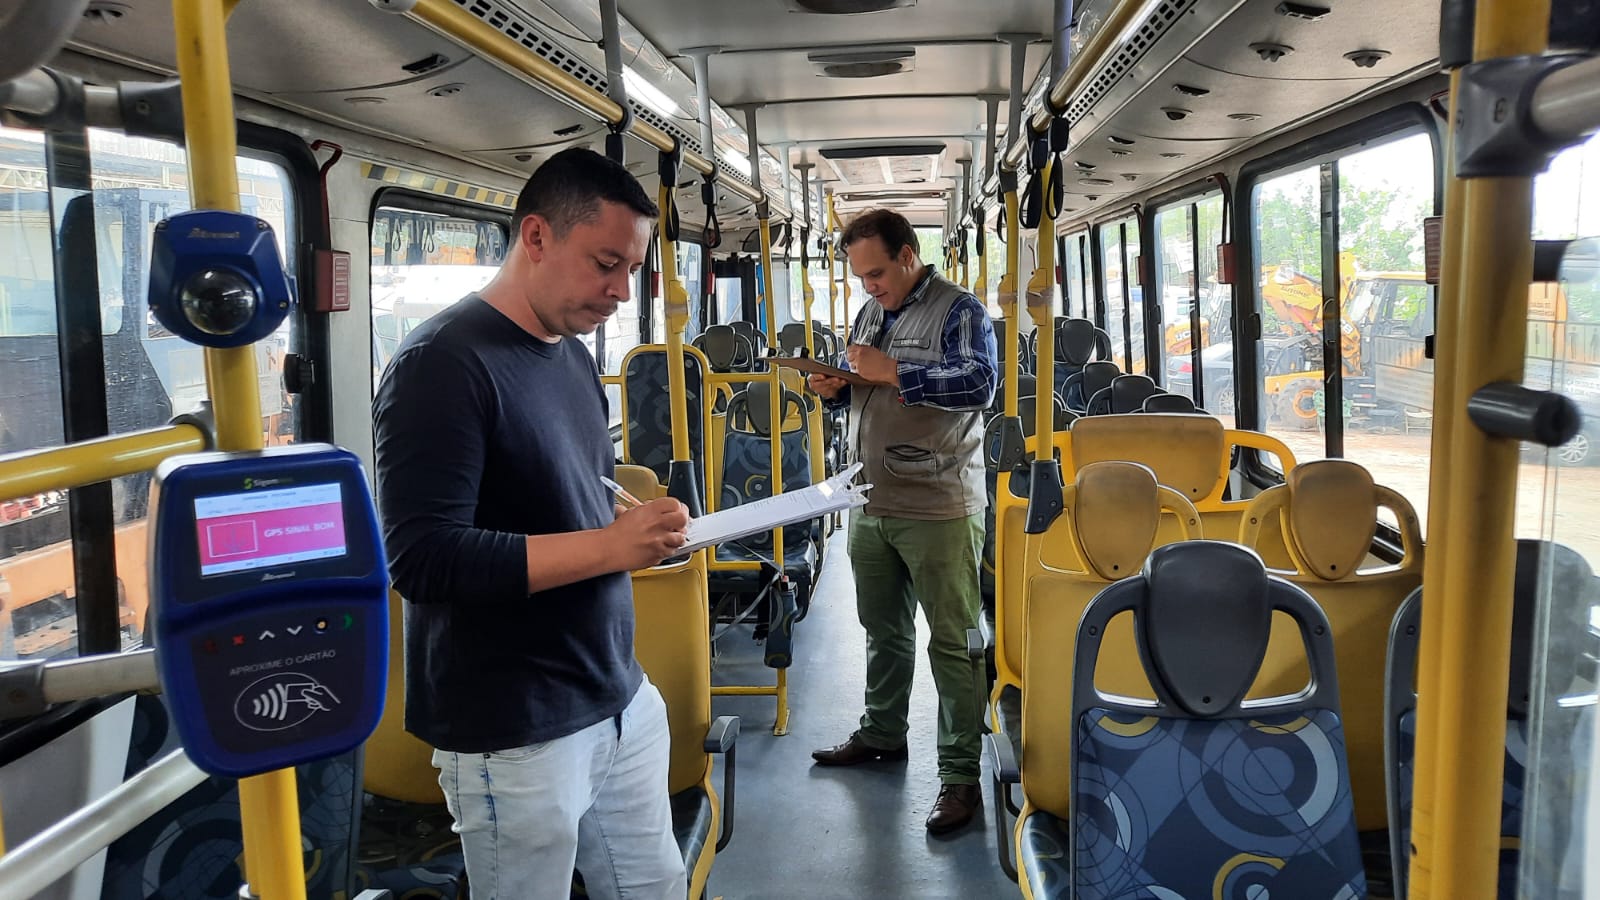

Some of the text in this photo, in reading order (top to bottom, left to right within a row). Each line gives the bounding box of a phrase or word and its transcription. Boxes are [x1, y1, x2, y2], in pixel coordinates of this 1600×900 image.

[263, 521, 336, 538] GPS SINAL BOM
[230, 660, 281, 675] APROXIME
[285, 657, 293, 666] O
